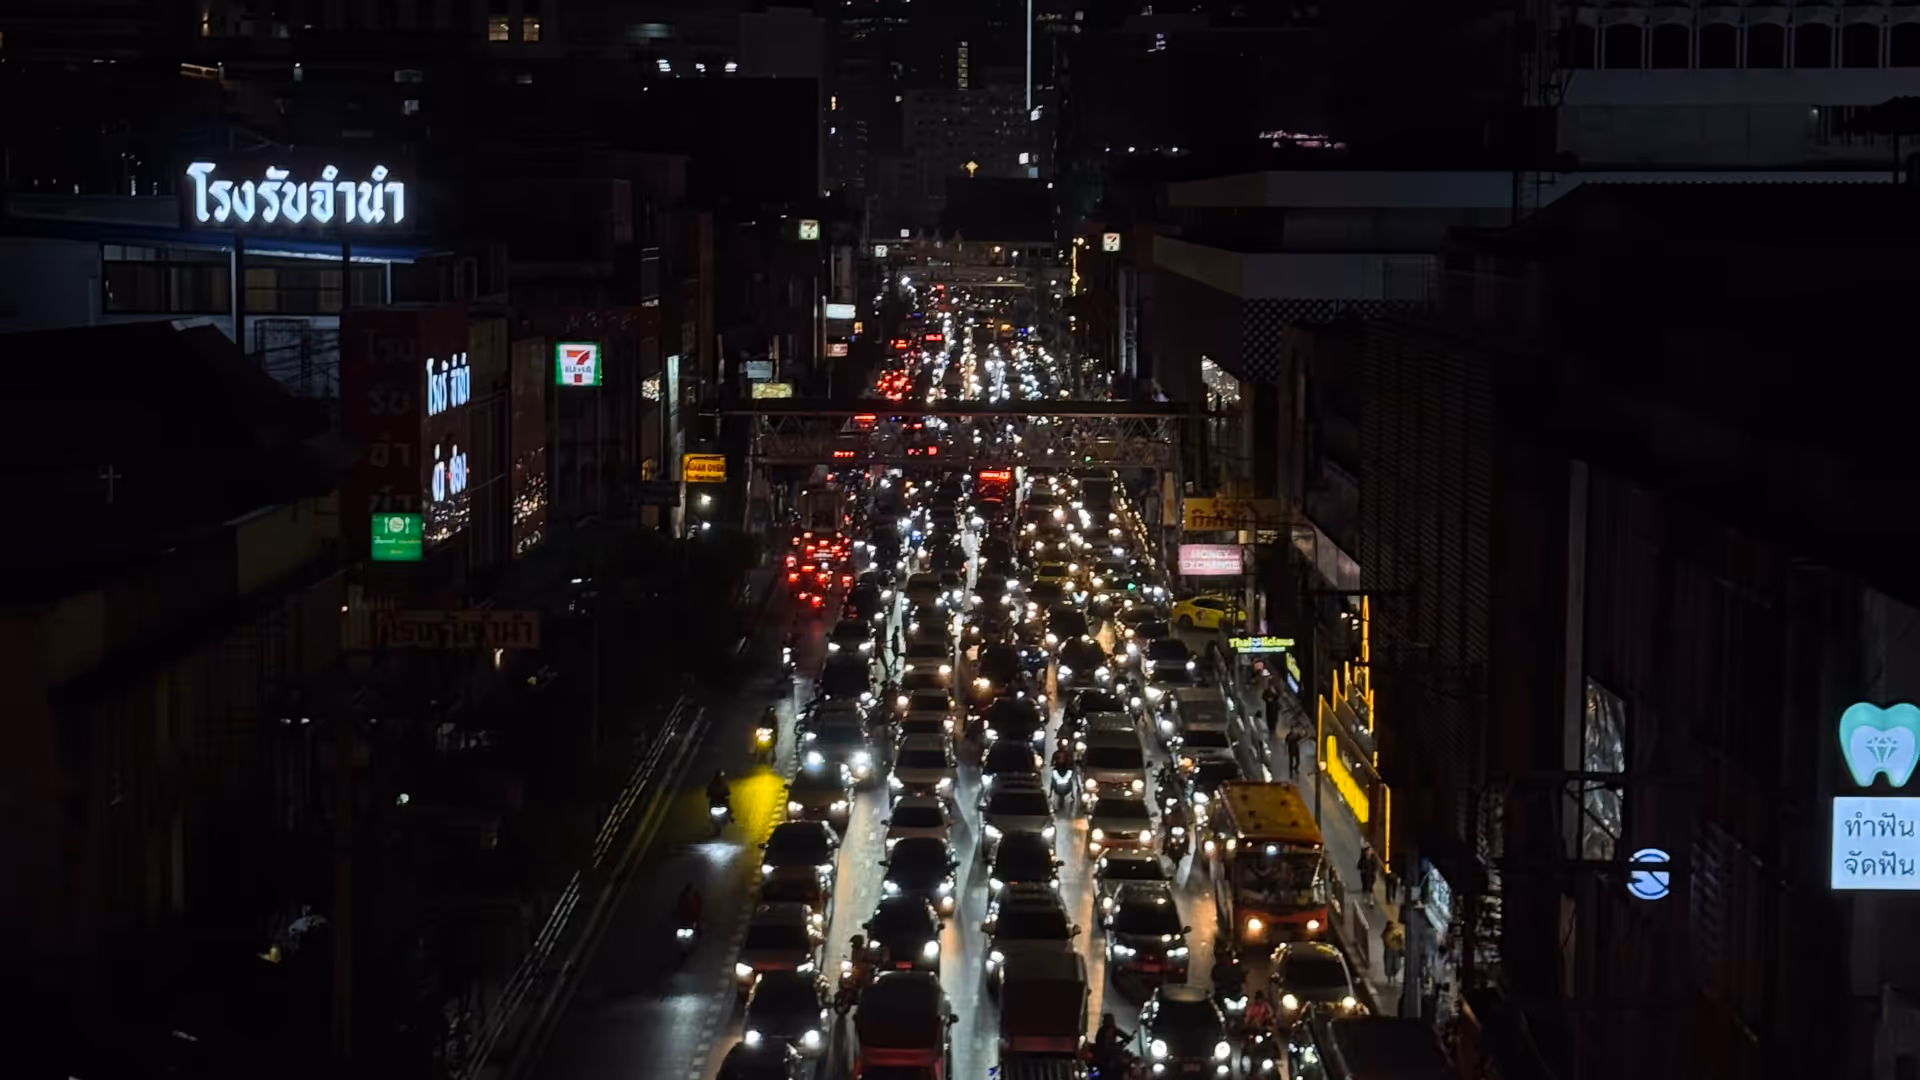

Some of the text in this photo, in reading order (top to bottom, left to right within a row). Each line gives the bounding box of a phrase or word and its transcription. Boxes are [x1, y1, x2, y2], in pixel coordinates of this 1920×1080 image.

[186, 162, 405, 224] โรงรับจำนำ
[1845, 811, 1915, 837] ทำฟัน
[1844, 850, 1915, 876] จัดฟัน
